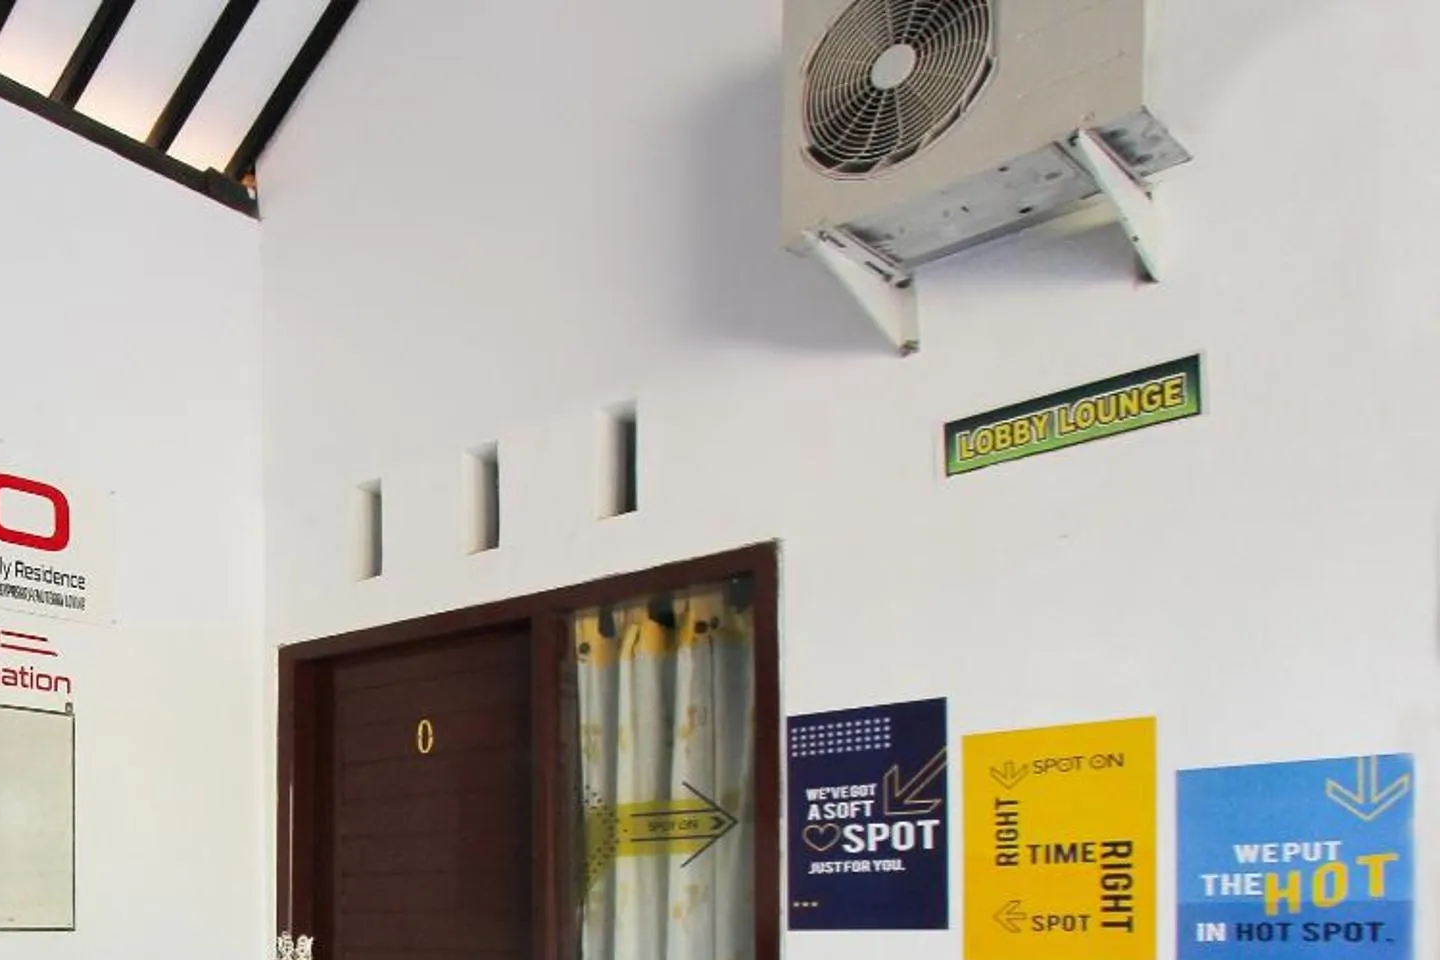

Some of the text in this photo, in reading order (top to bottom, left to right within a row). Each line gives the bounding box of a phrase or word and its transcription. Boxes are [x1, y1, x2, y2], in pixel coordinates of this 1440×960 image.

[960, 375, 1185, 461] LOBBY LOUNGE
[15, 561, 86, 590] Residence
[1033, 752, 1124, 774] SPOT ON
[806, 783, 877, 801] WE'VE GOT
[807, 800, 874, 820] A SOFT
[841, 819, 940, 853] SPOT
[994, 797, 1019, 867] RIGHT
[1026, 841, 1097, 865] TIME
[1232, 840, 1343, 864] WE PUT
[808, 861, 843, 875] JUST
[843, 860, 871, 873] FOR
[1100, 840, 1133, 933] RIGHT
[1199, 852, 1400, 917] THE HOT
[1032, 914, 1090, 932] SPOT
[1196, 921, 1395, 943] IN HOT SPOT.
